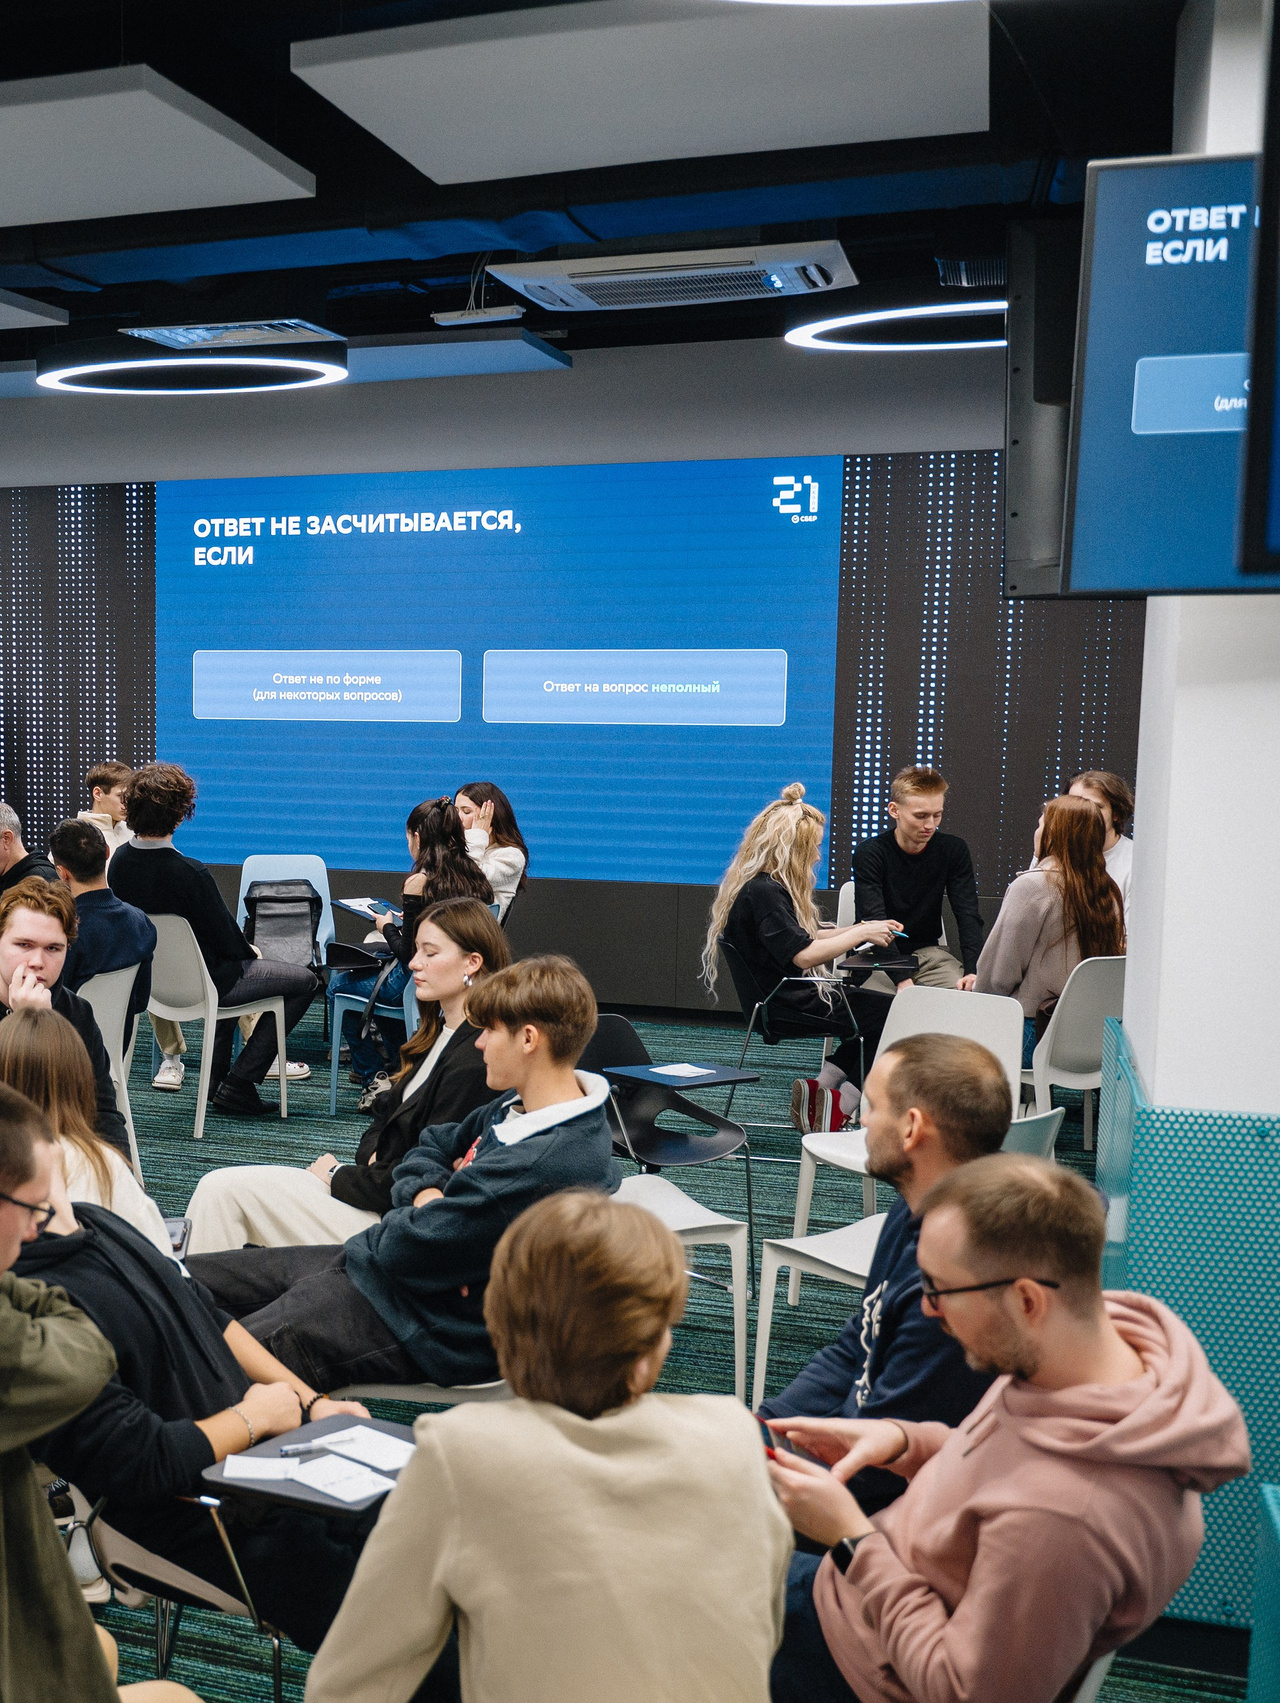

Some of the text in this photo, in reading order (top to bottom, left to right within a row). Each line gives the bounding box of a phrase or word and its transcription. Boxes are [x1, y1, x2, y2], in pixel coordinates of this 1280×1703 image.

[1146, 203, 1248, 234] ОТВЕТ
[1145, 236, 1229, 265] ЕСЛИ
[772, 475, 819, 514] 21
[193, 509, 522, 538] ОТВЕТ НЕ ЗАСЧИТЫВАЕТСЯ,
[194, 546, 254, 566] ЕСЛИ
[272, 672, 382, 686] Ответ не по форме
[543, 680, 720, 695] Ответ на вопрос неполный
[252, 688, 403, 703] (для некоторых вопросов)
